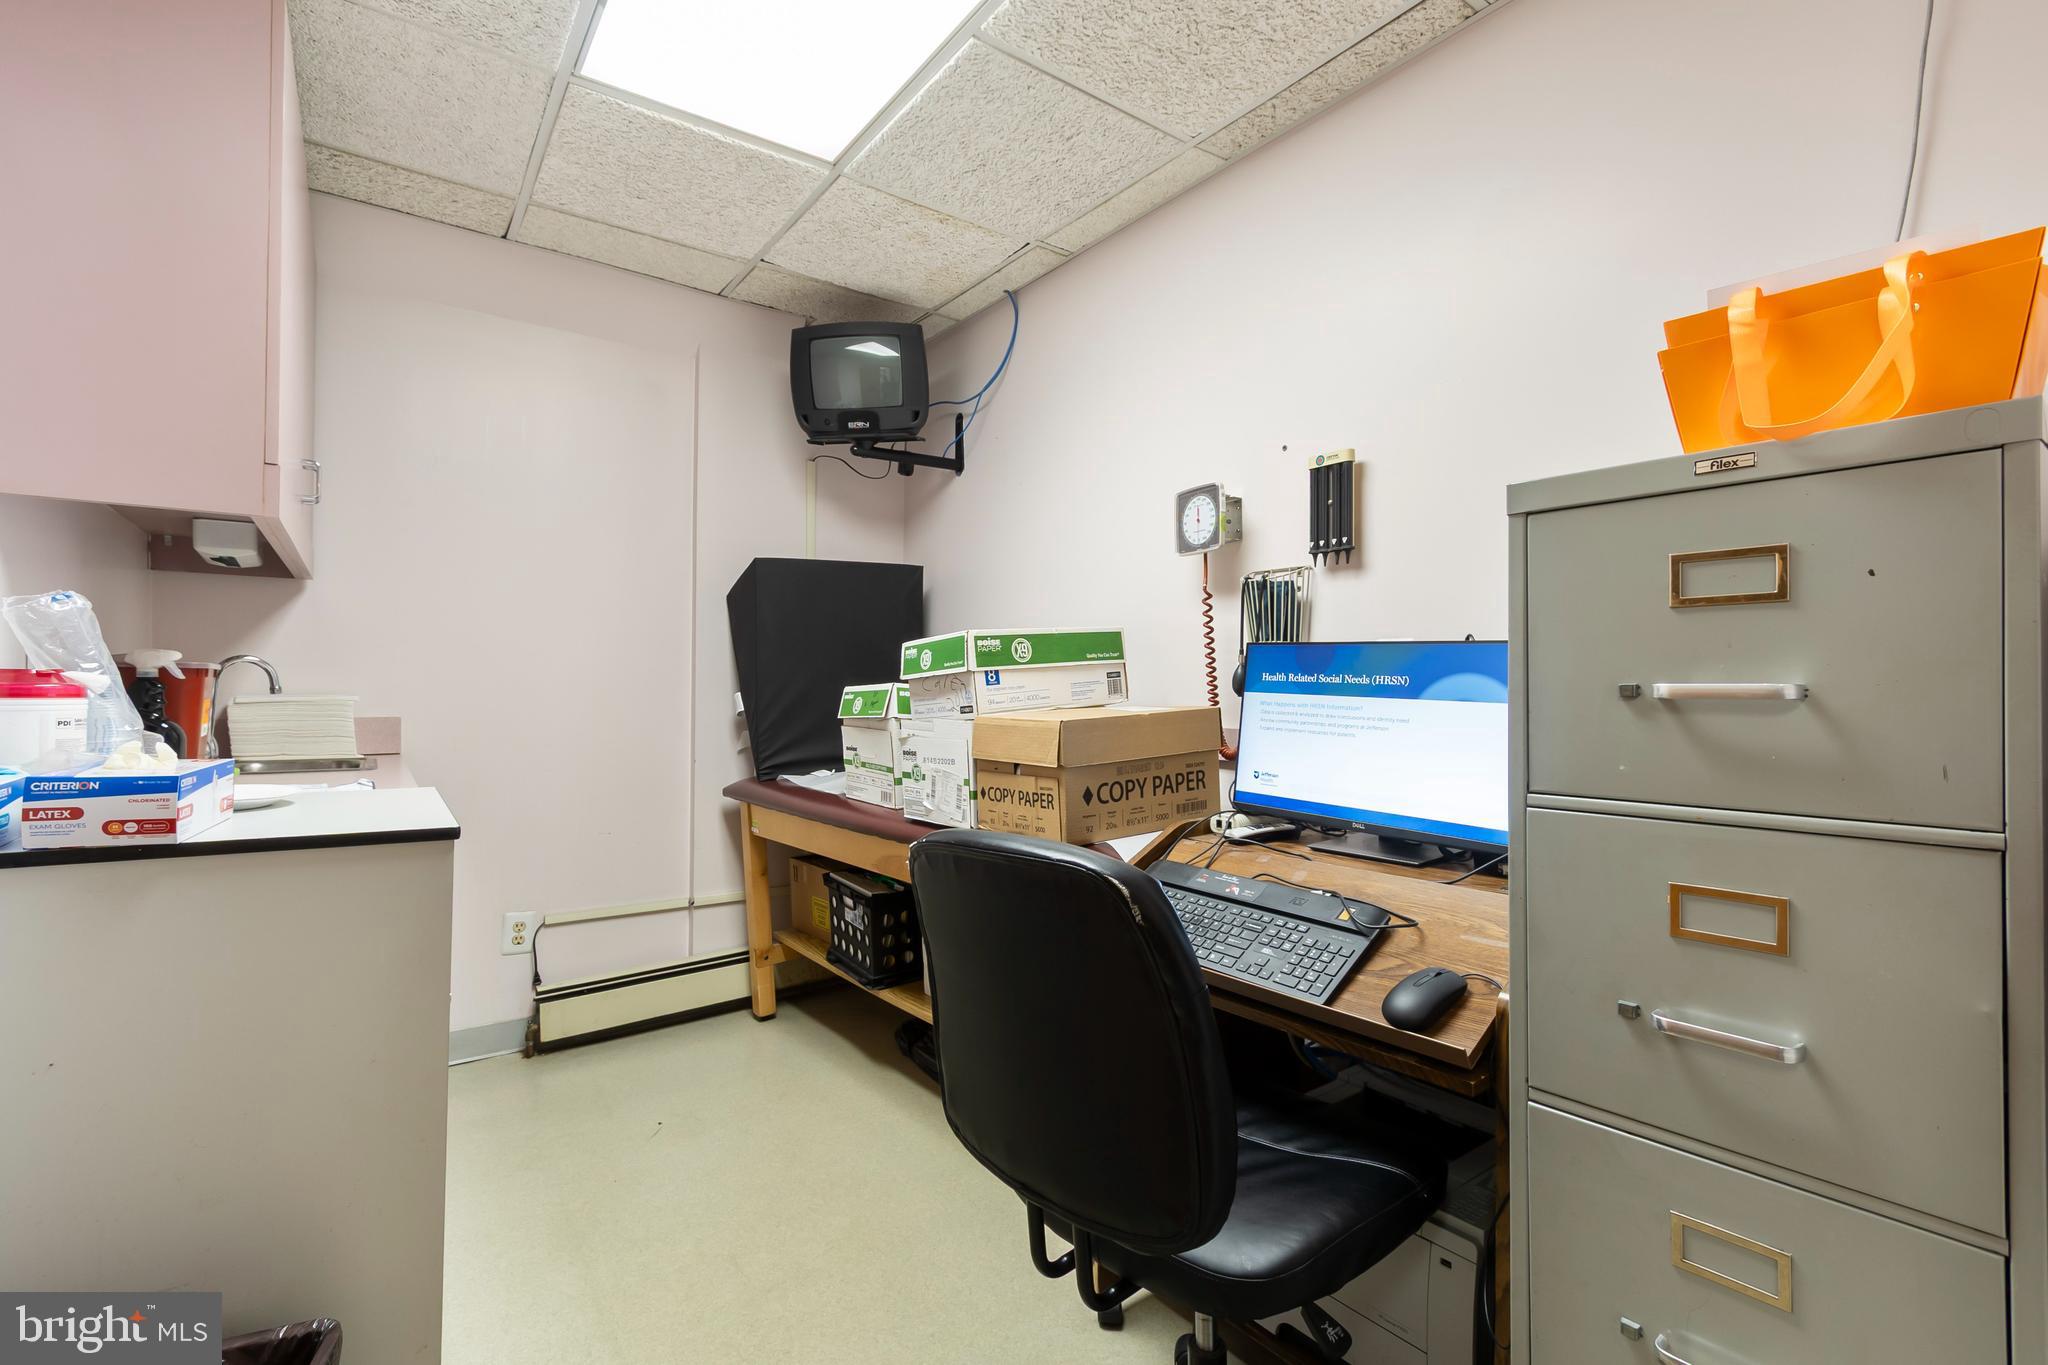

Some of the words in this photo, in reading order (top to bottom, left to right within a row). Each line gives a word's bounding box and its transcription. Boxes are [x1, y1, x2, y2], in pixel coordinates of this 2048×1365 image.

[1710, 458, 1739, 470] filex
[977, 645, 1002, 653] PAPER
[1262, 672, 1286, 682] Health
[1288, 673, 1317, 683] Related
[1318, 674, 1343, 684] Social
[1344, 675, 1370, 685] Needs
[1371, 675, 1410, 687] (HRSN)
[30, 781, 100, 791] CRITERION
[1096, 777, 1148, 804] COPY
[1152, 770, 1207, 796] PAPER
[987, 786, 1016, 805] COPY
[1018, 790, 1055, 810] PAPER
[29, 809, 72, 819] LATEX
[1155, 813, 1170, 821] 5000
[29, 823, 53, 831] EXAM
[53, 822, 87, 830] GLOVES
